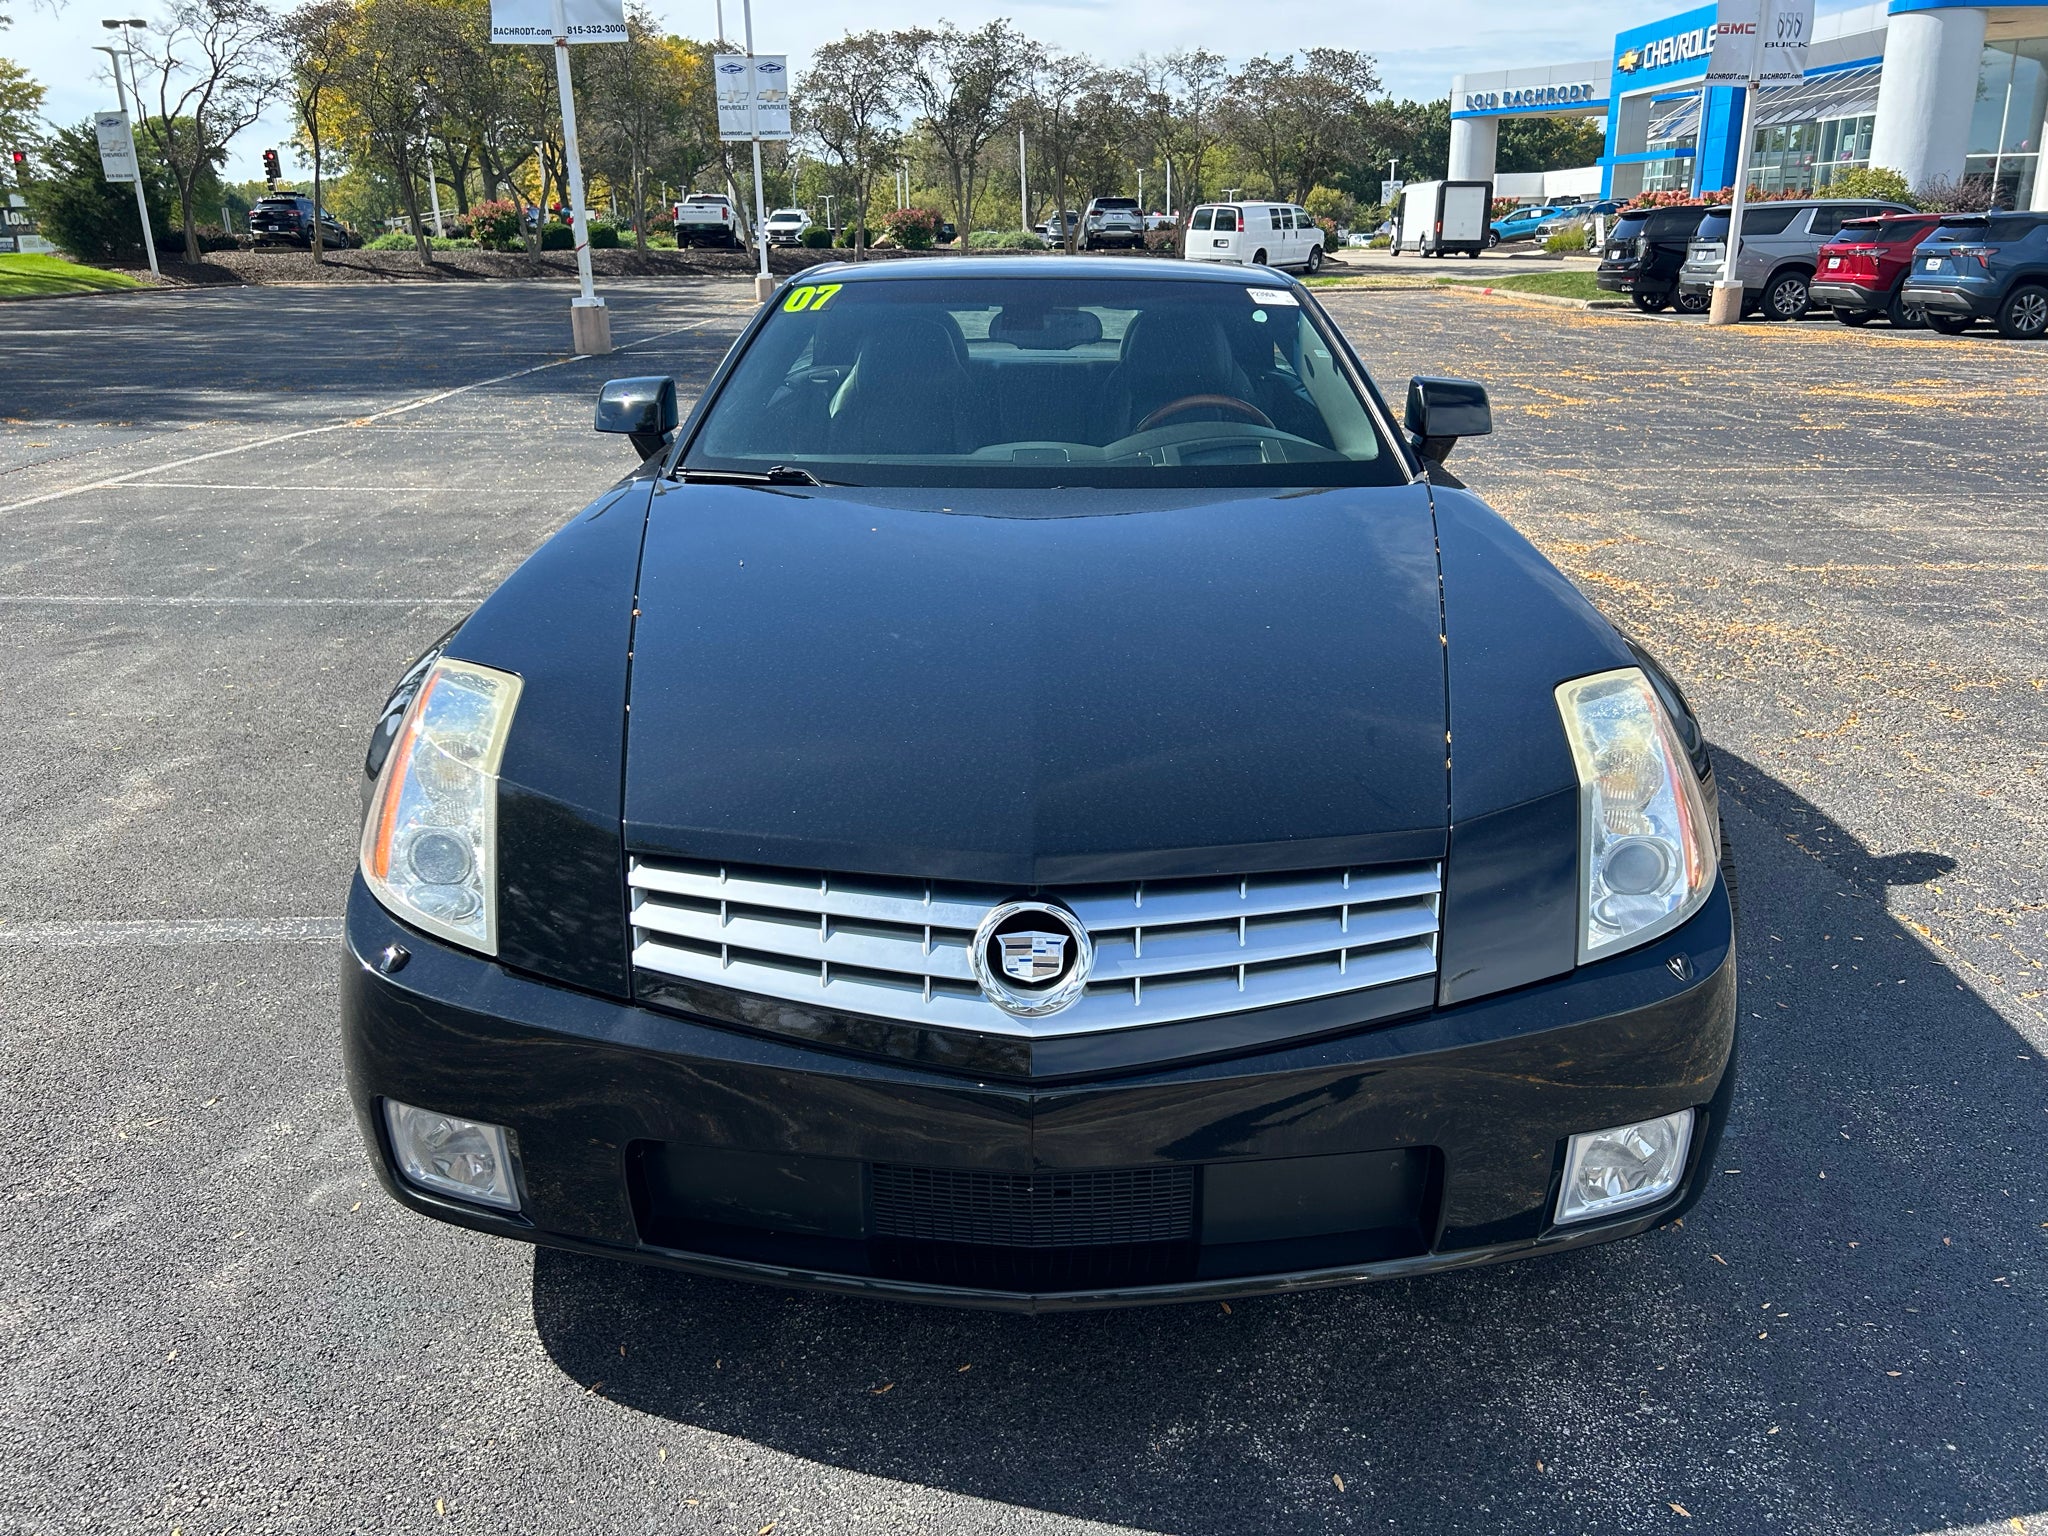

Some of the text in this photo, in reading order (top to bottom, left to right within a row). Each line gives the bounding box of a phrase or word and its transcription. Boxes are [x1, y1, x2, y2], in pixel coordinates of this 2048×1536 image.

[493, 27, 552, 36] BACHRODT.com
[567, 24, 626, 35] 815-332-3000
[1717, 23, 1757, 35] GMC
[1643, 24, 1718, 69] CHEVROLE
[1760, 72, 1804, 80] BACHRODT.com
[1466, 84, 1592, 108] LOU BACHRODT
[783, 284, 843, 312] 07
